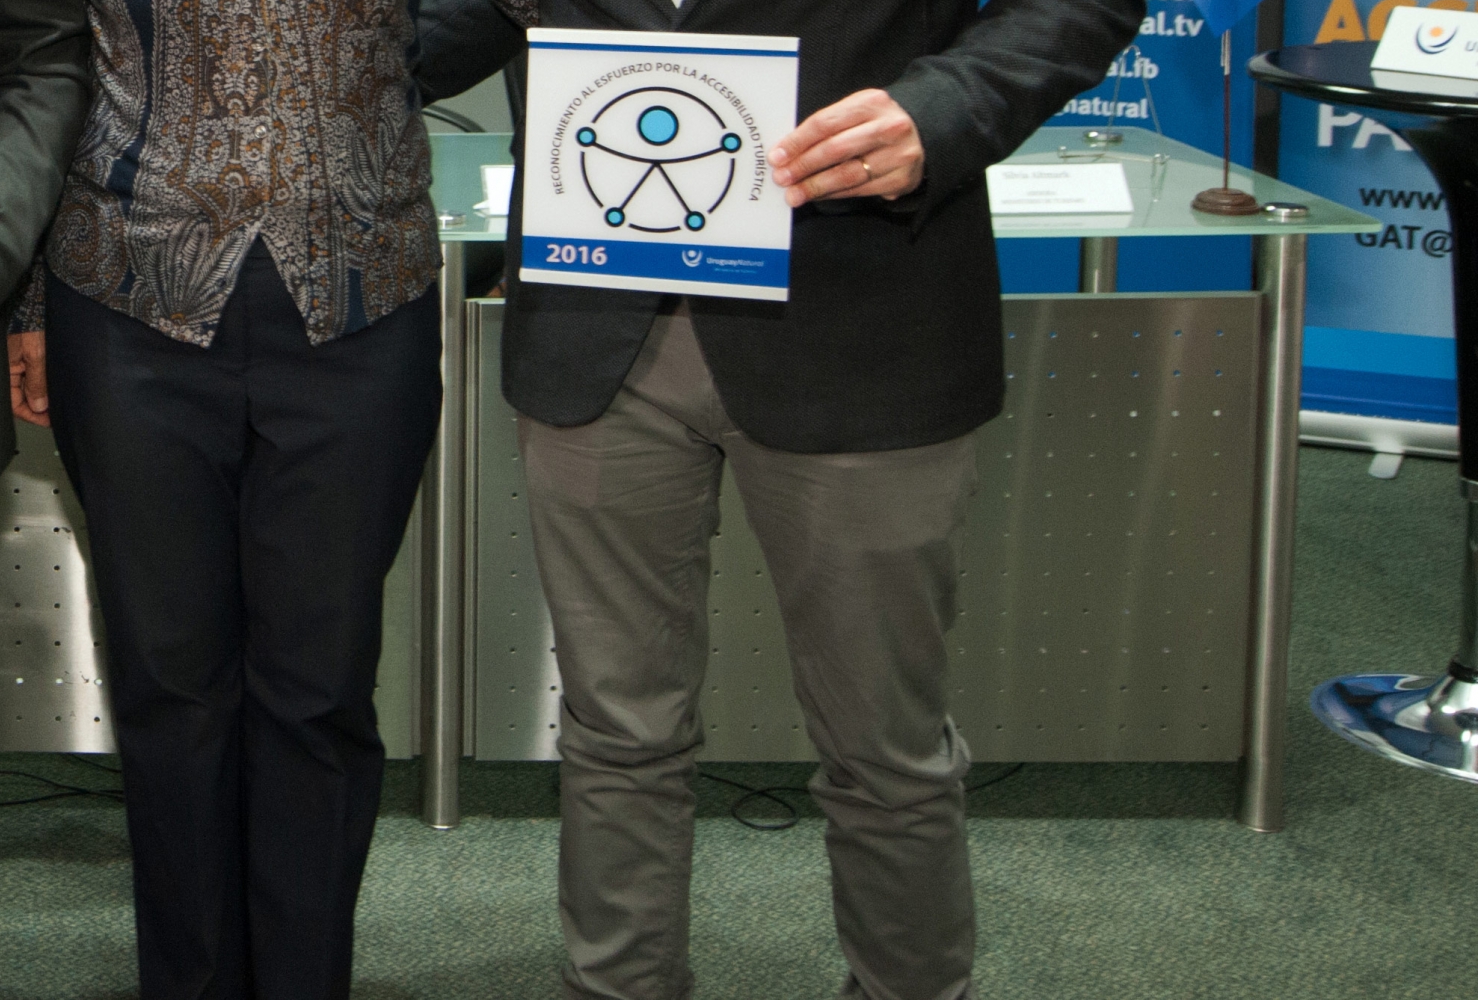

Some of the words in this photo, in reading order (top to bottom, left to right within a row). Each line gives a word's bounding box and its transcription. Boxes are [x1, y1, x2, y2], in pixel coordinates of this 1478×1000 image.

[1139, 11, 1204, 37] al.tv
[550, 97, 582, 195] RECONOCIMIENTO
[581, 85, 595, 100] AL
[594, 62, 653, 88] ESFUERZO
[655, 62, 680, 74] POR
[683, 66, 697, 79] LA
[699, 73, 761, 142] ACCESIBILIDAD
[749, 143, 766, 202] TURÍSTICA
[545, 243, 608, 266] 2016
[1354, 223, 1453, 258] GAT@
